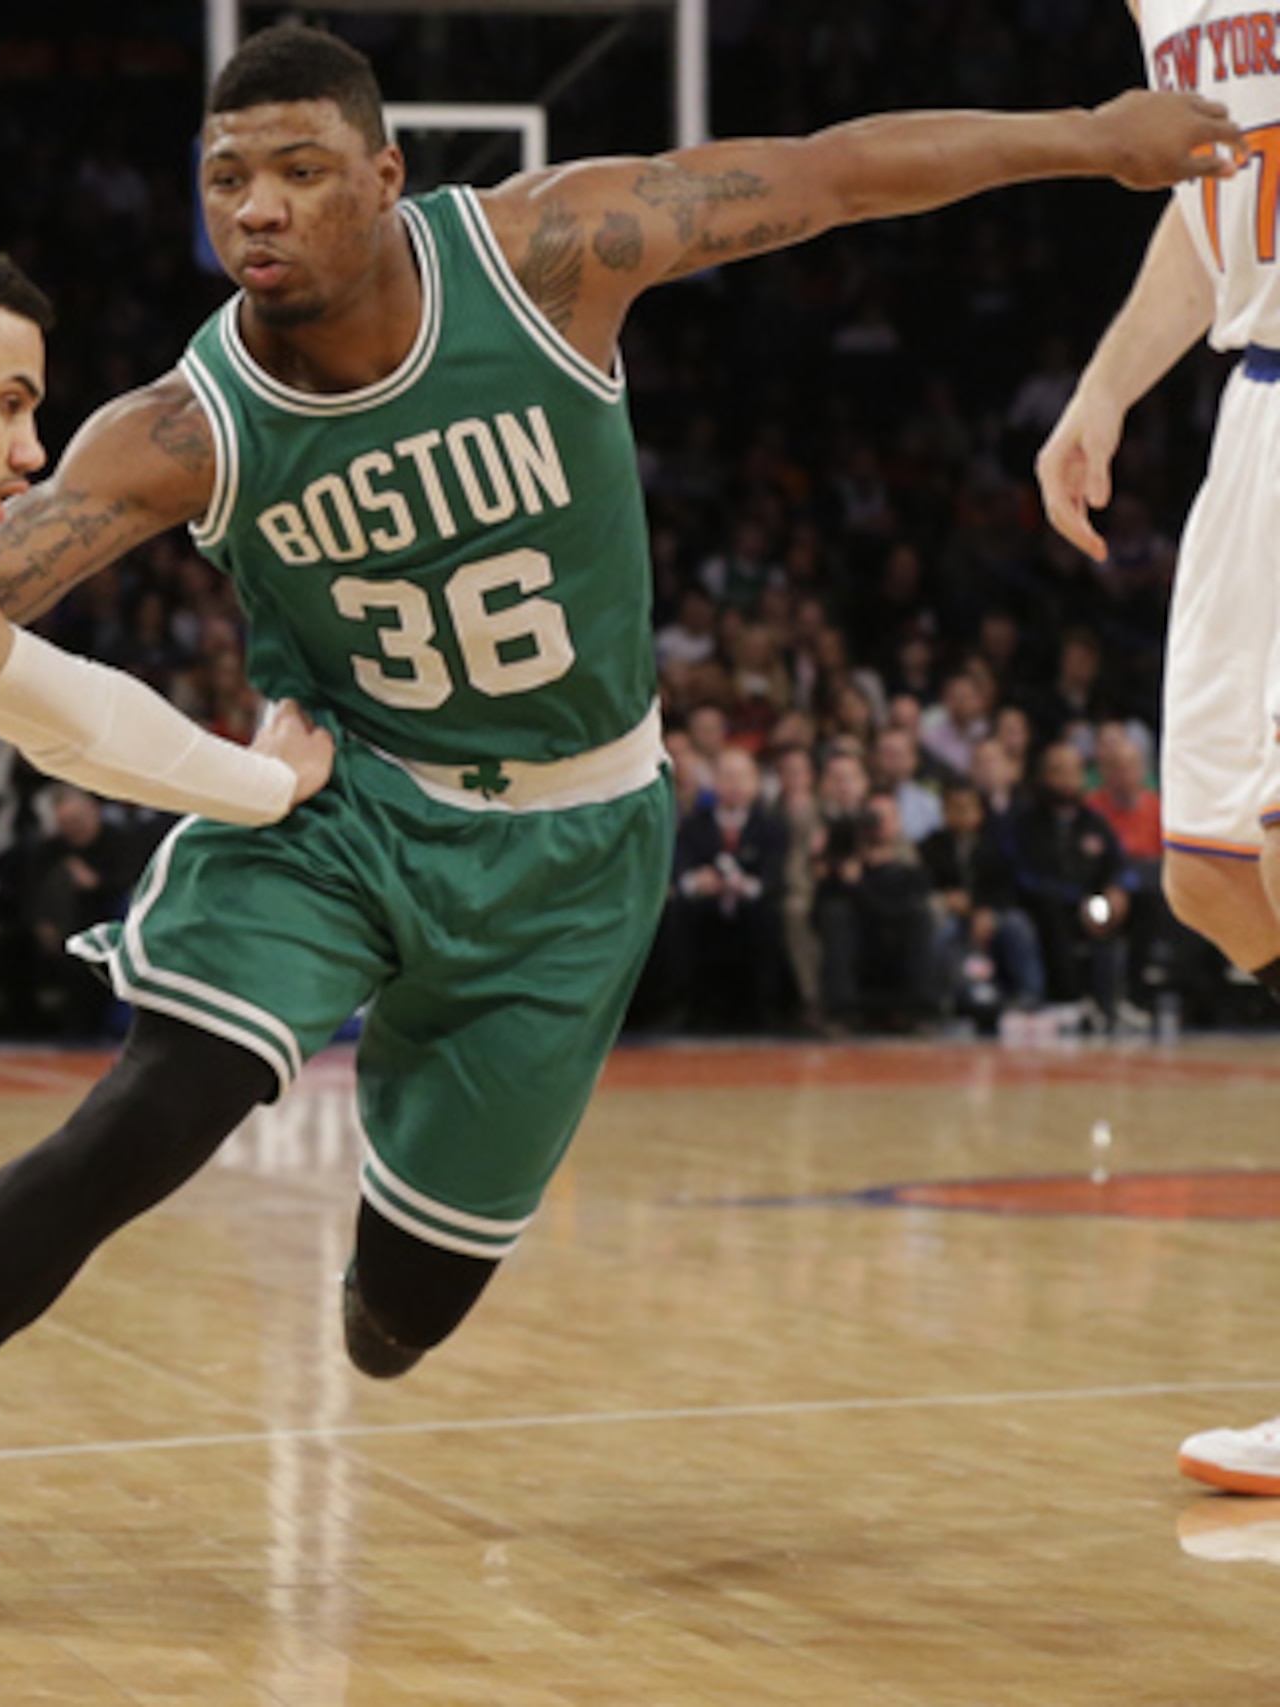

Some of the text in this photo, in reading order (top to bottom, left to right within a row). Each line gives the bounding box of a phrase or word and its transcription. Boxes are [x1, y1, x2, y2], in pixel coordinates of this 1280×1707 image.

[1154, 11, 1280, 92] EW YOR
[256, 405, 572, 566] BOSTON
[330, 547, 576, 710] 36
